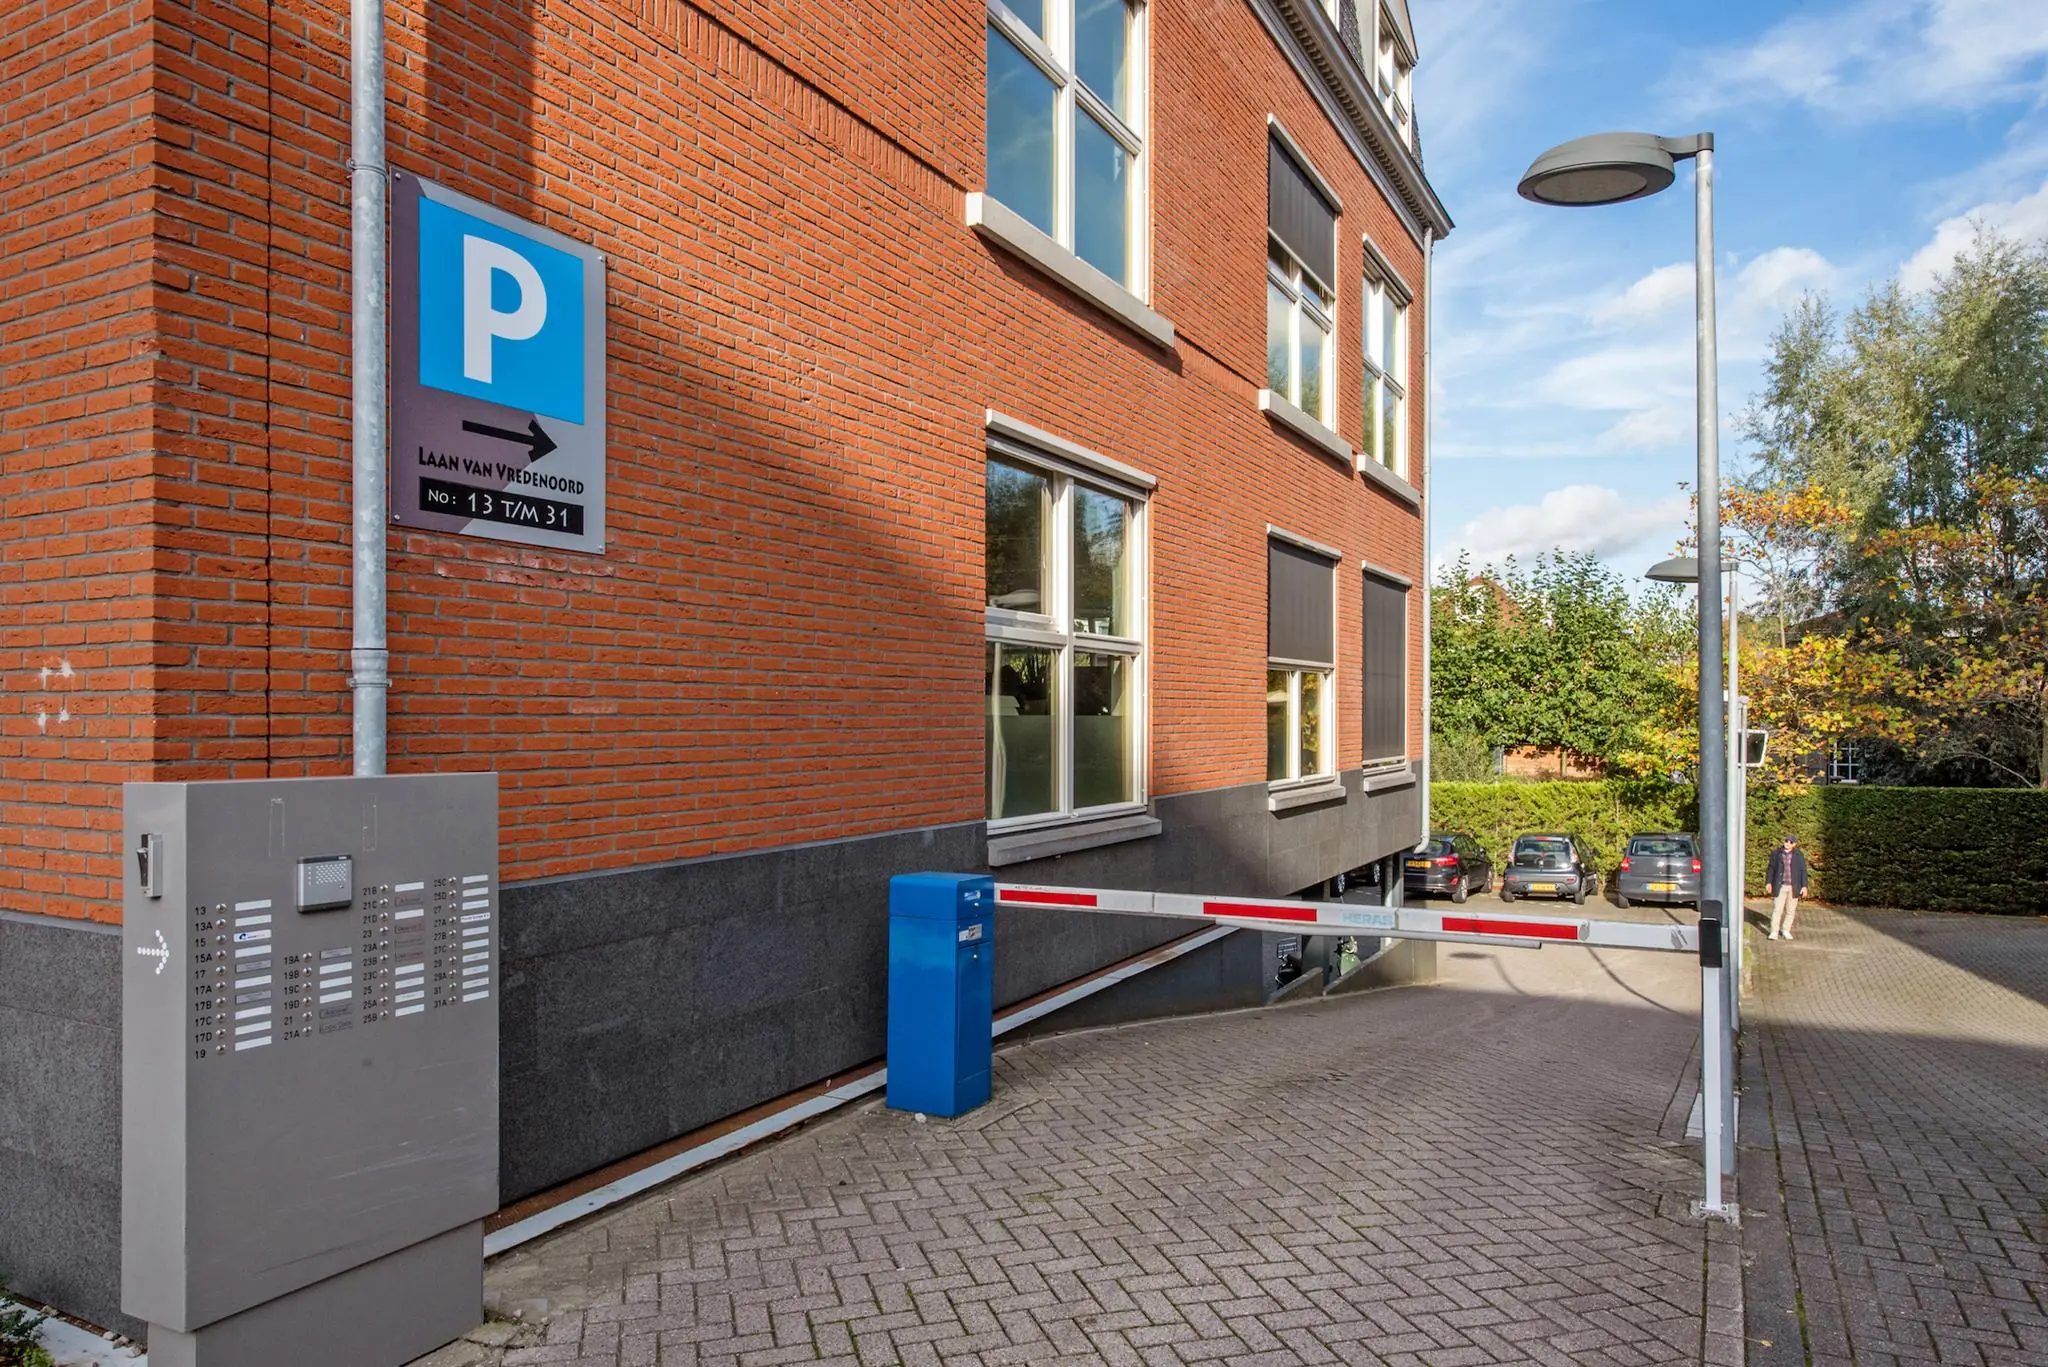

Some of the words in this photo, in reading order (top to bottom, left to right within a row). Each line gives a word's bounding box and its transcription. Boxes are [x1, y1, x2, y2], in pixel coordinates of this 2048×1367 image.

[463, 233, 548, 385] P
[467, 491, 494, 515] 13
[500, 500, 540, 523] T/M
[545, 504, 569, 528] 31
[363, 887, 378, 896] 21B
[363, 901, 378, 910] 21C
[195, 906, 207, 916] 13
[363, 915, 378, 924] 21D
[434, 919, 447, 928] 27A
[1341, 912, 1393, 926] HERAS
[195, 921, 214, 932] 13A
[363, 930, 373, 938] 23
[434, 932, 447, 941] 27B
[195, 938, 207, 947] 15
[363, 943, 378, 953] 23A
[434, 945, 448, 954] 27C
[195, 954, 214, 963] 15A
[284, 956, 300, 964] 19A
[363, 957, 378, 966] 23B
[195, 970, 206, 979] 17
[284, 970, 301, 980] 19B
[195, 985, 213, 995] 17A
[284, 985, 300, 995] 19C
[363, 986, 373, 995] 25
[195, 1001, 213, 1011] 17B
[284, 1000, 300, 1009] 19D
[363, 1000, 378, 1009] 25A
[195, 1017, 213, 1026] 17C
[284, 1016, 293, 1025] 21
[363, 1013, 378, 1024] 25B
[195, 1032, 213, 1043] 17D
[284, 1031, 301, 1040] 21A
[195, 1049, 207, 1058] 19
